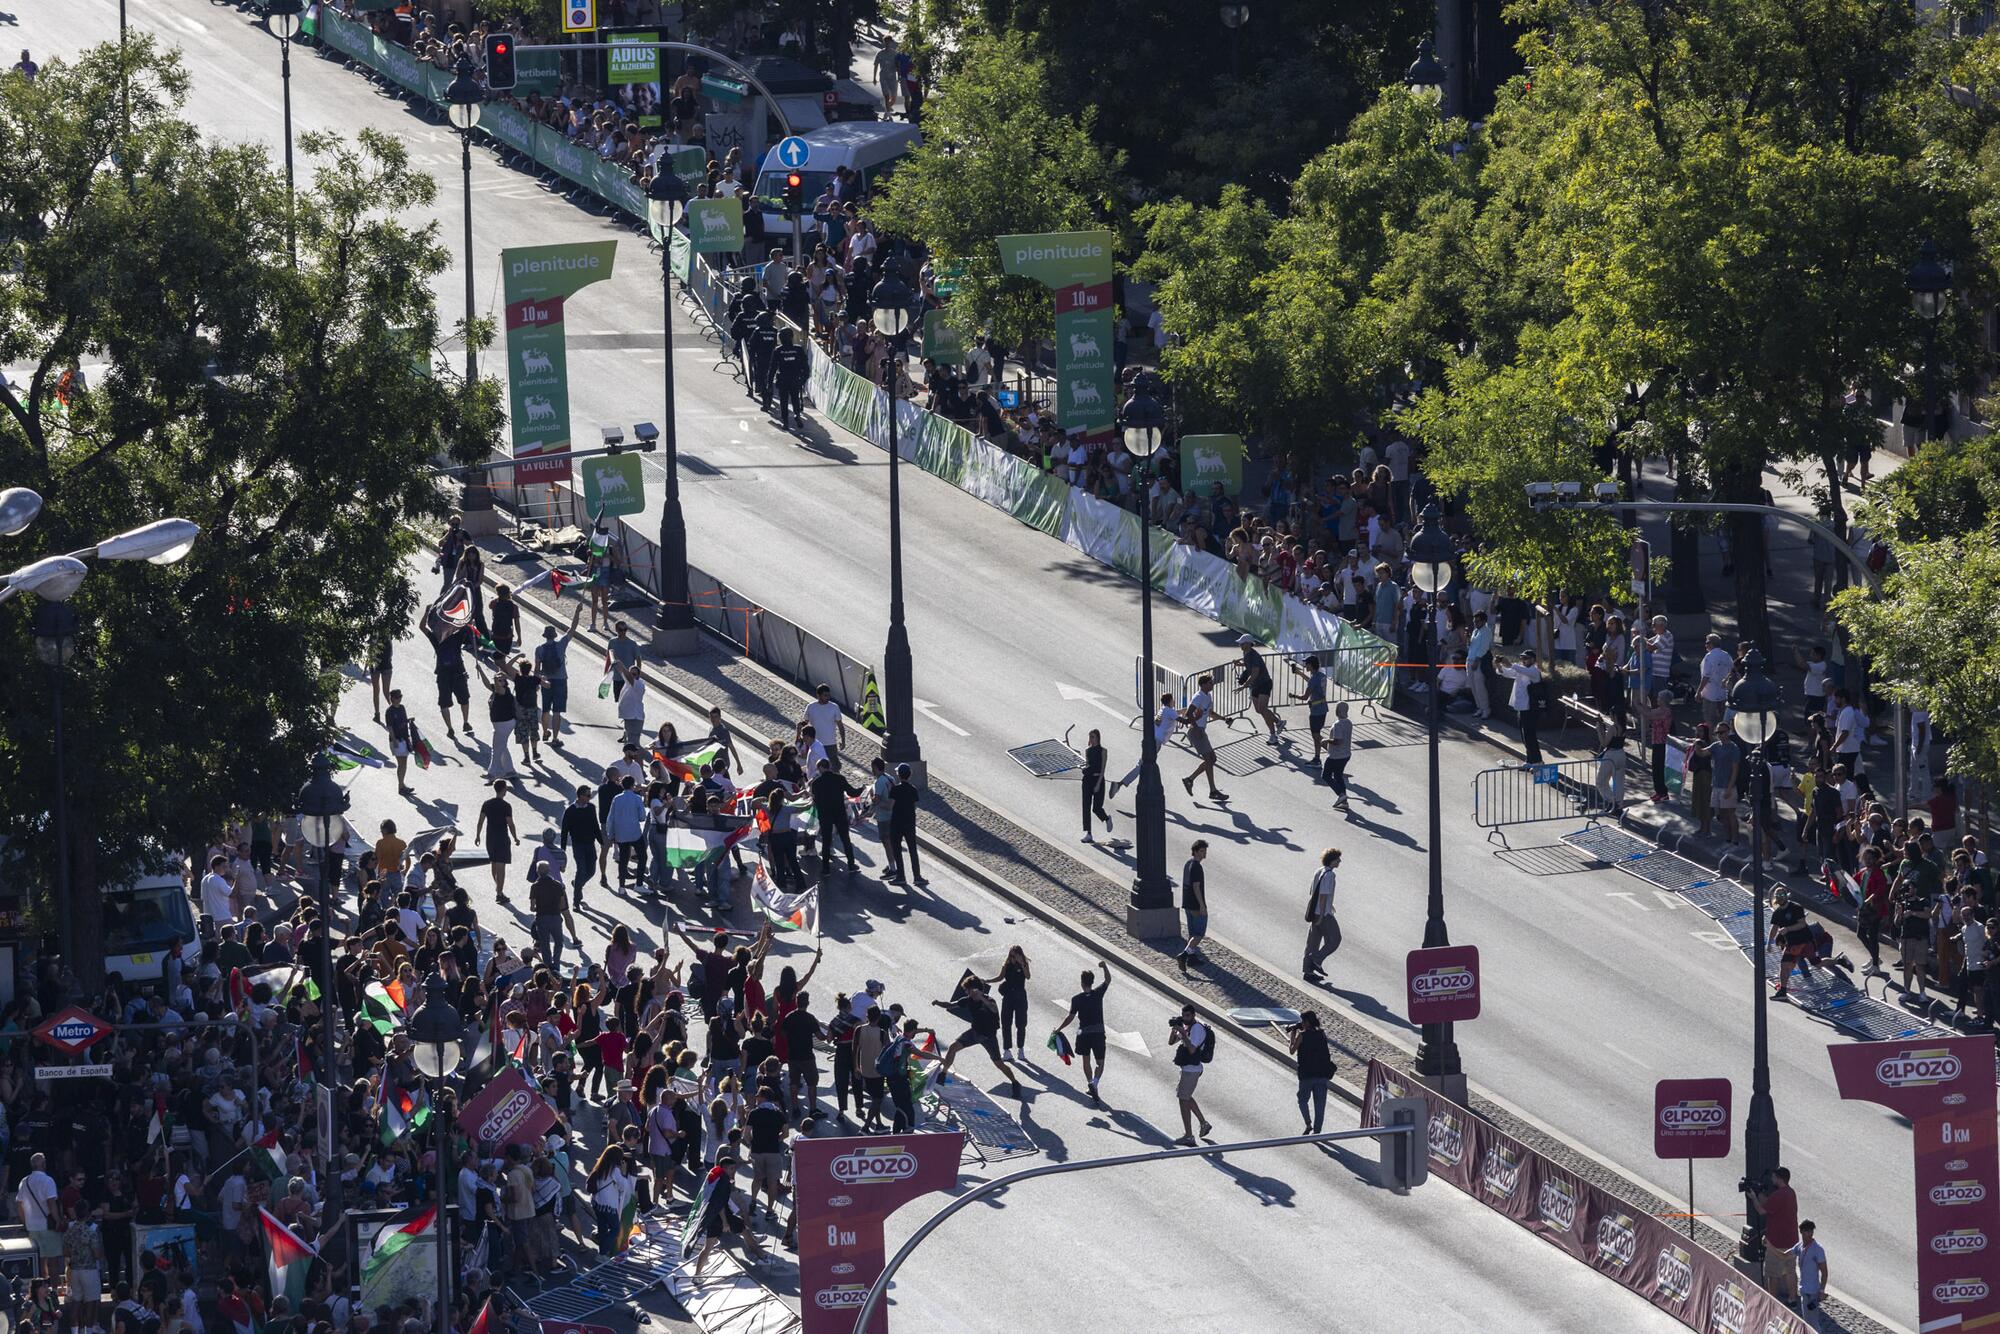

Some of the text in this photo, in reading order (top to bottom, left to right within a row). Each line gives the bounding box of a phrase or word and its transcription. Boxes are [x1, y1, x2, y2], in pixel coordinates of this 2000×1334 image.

[1015, 242, 1103, 264] plenitude
[512, 254, 601, 278] plenitude
[1071, 290, 1098, 306] 10 KM
[521, 305, 548, 322] 10 KM
[1065, 360, 1105, 371] plenitude
[518, 377, 560, 387] plenitude
[1066, 407, 1106, 418] plenitude
[521, 423, 561, 434] plenitude
[57, 1026, 91, 1037] Metro
[38, 1068, 63, 1077] Banco
[66, 1068, 77, 1076] de
[1942, 1122, 1970, 1143] 8 KM
[827, 1225, 857, 1246] 8 KM
